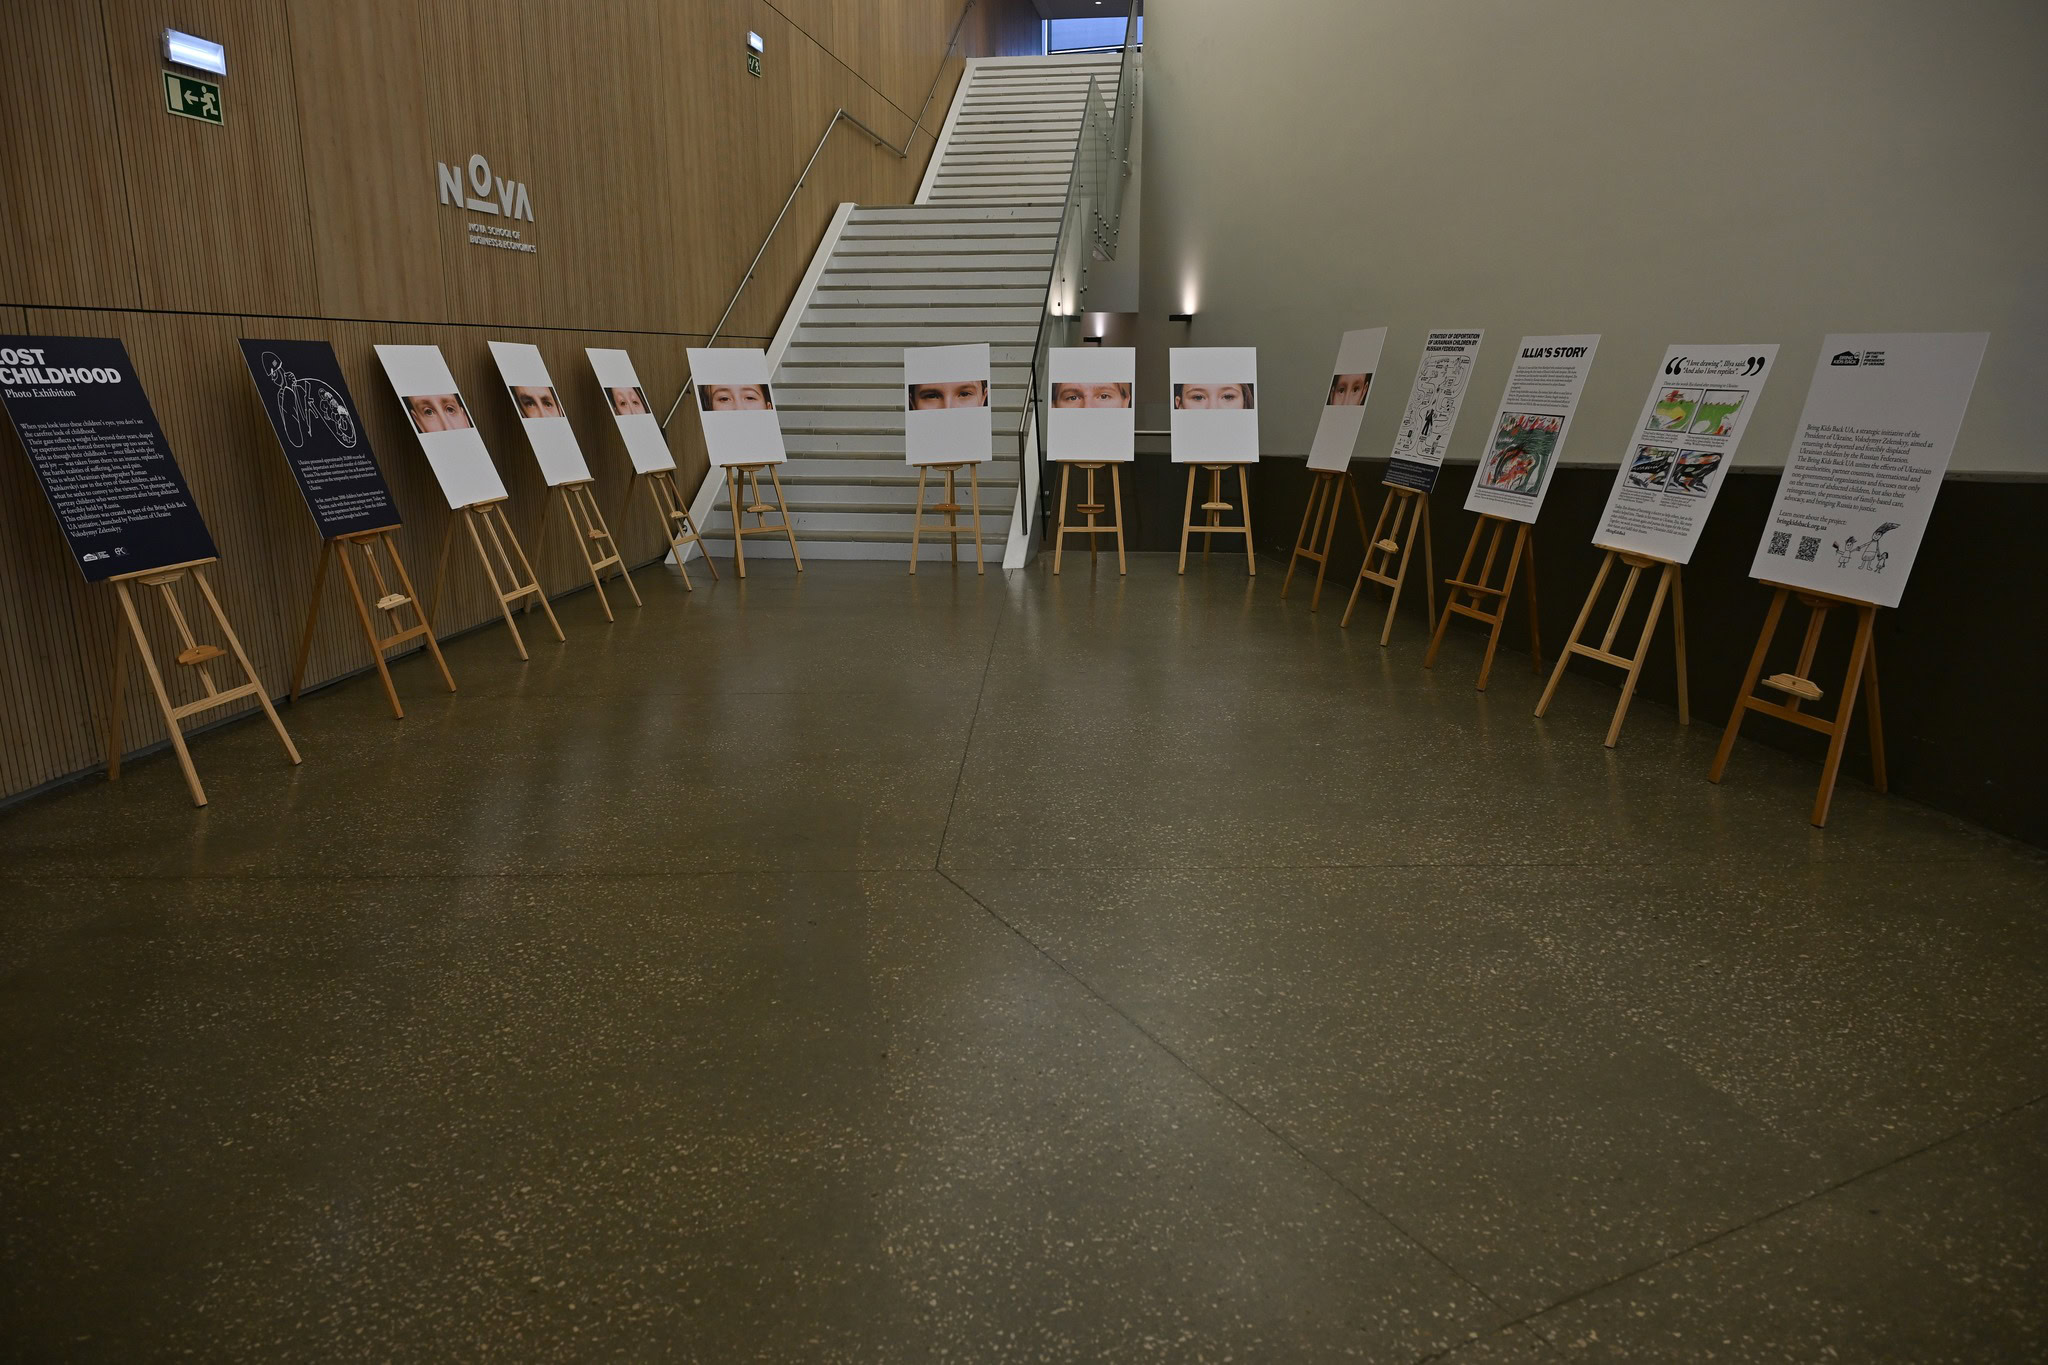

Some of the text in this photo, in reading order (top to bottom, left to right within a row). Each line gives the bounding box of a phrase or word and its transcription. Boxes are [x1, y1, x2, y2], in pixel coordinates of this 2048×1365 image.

[438, 154, 534, 222] NOVA
[468, 223, 520, 240] NOVA SCHOOL OF
[470, 235, 498, 247] BUSINESS
[503, 241, 536, 253] ECONOMICS
[0, 348, 45, 365] OST
[1522, 347, 1588, 358] ILLIA'S STORY
[0, 367, 122, 385] CHILDHOOD
[4, 387, 77, 398] Photo Exhibition
[1806, 424, 1820, 433] Bring
[1859, 429, 1881, 437] strategic
[1855, 436, 1882, 445] Volodymyr
[1801, 441, 1824, 449] returning
[1832, 442, 1855, 451] deported
[1865, 445, 1886, 454] forcibly
[1885, 446, 1911, 456] displaced
[1807, 456, 1821, 465] Bring
[1905, 466, 1932, 474] Ukrainian
[1875, 472, 1910, 481] international
[1791, 473, 1834, 481] non-governmental
[1877, 480, 1897, 489] focuses
[1908, 484, 1921, 494] only
[1825, 483, 1849, 492] abducted
[1815, 498, 1836, 509] bringing
[1859, 495, 1892, 506] family-based
[99, 517, 122, 525] launched
[1776, 517, 1827, 531] bringkidsback.org.ua
